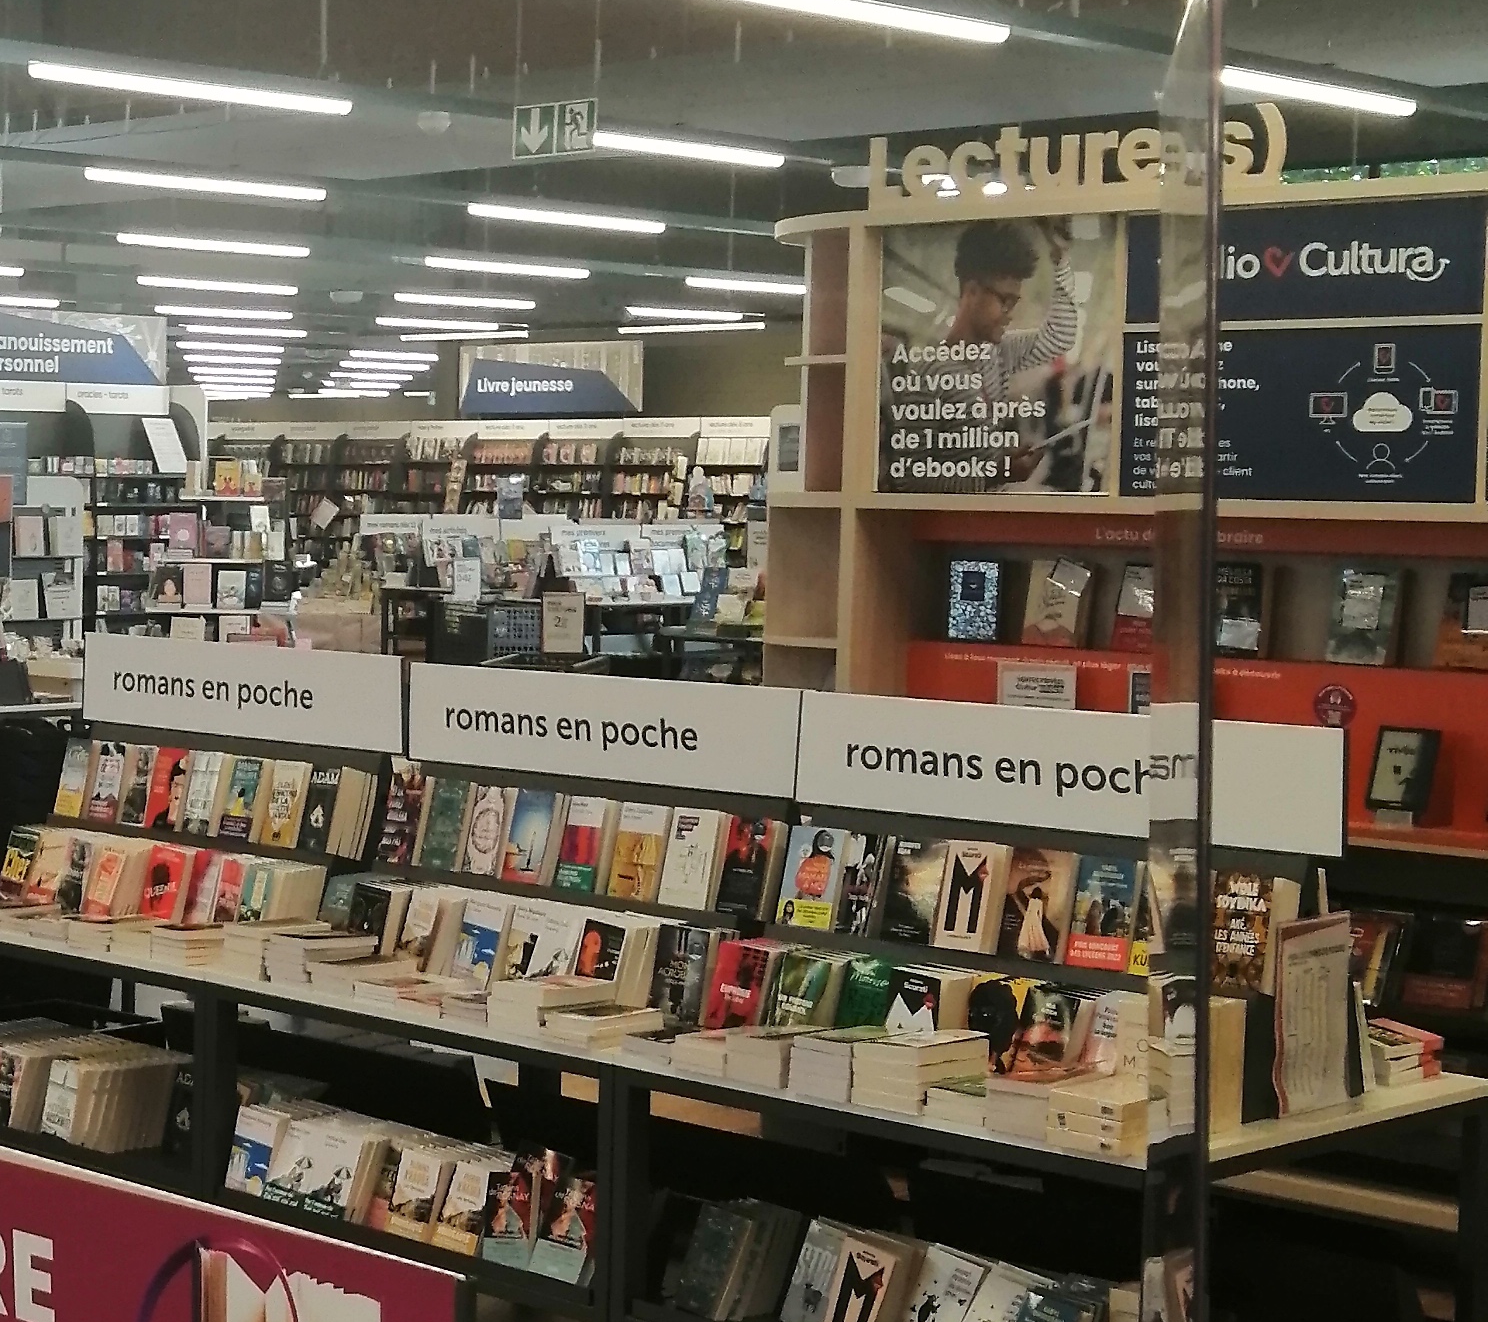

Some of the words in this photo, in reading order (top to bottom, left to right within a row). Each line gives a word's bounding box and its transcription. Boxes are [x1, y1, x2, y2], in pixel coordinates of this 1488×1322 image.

[1299, 240, 1444, 280] Cultura
[892, 340, 991, 364] Accédez
[477, 377, 509, 393] Livre
[510, 377, 574, 396] jeunesse
[892, 371, 924, 392] où
[926, 372, 983, 391] vous
[891, 398, 967, 420] voulez
[971, 396, 990, 418] à
[992, 396, 1046, 426] près
[891, 429, 920, 449] de
[923, 429, 934, 448] 1
[938, 427, 1020, 449] million
[890, 457, 998, 479] d'ebooks
[113, 667, 196, 699] romans
[201, 680, 231, 703] en
[237, 675, 314, 713] poche
[444, 703, 548, 739] romans
[556, 717, 593, 743] en
[601, 714, 699, 754] poche
[846, 739, 983, 782] romans
[995, 752, 1043, 786] en
[1056, 757, 1150, 798] poch
